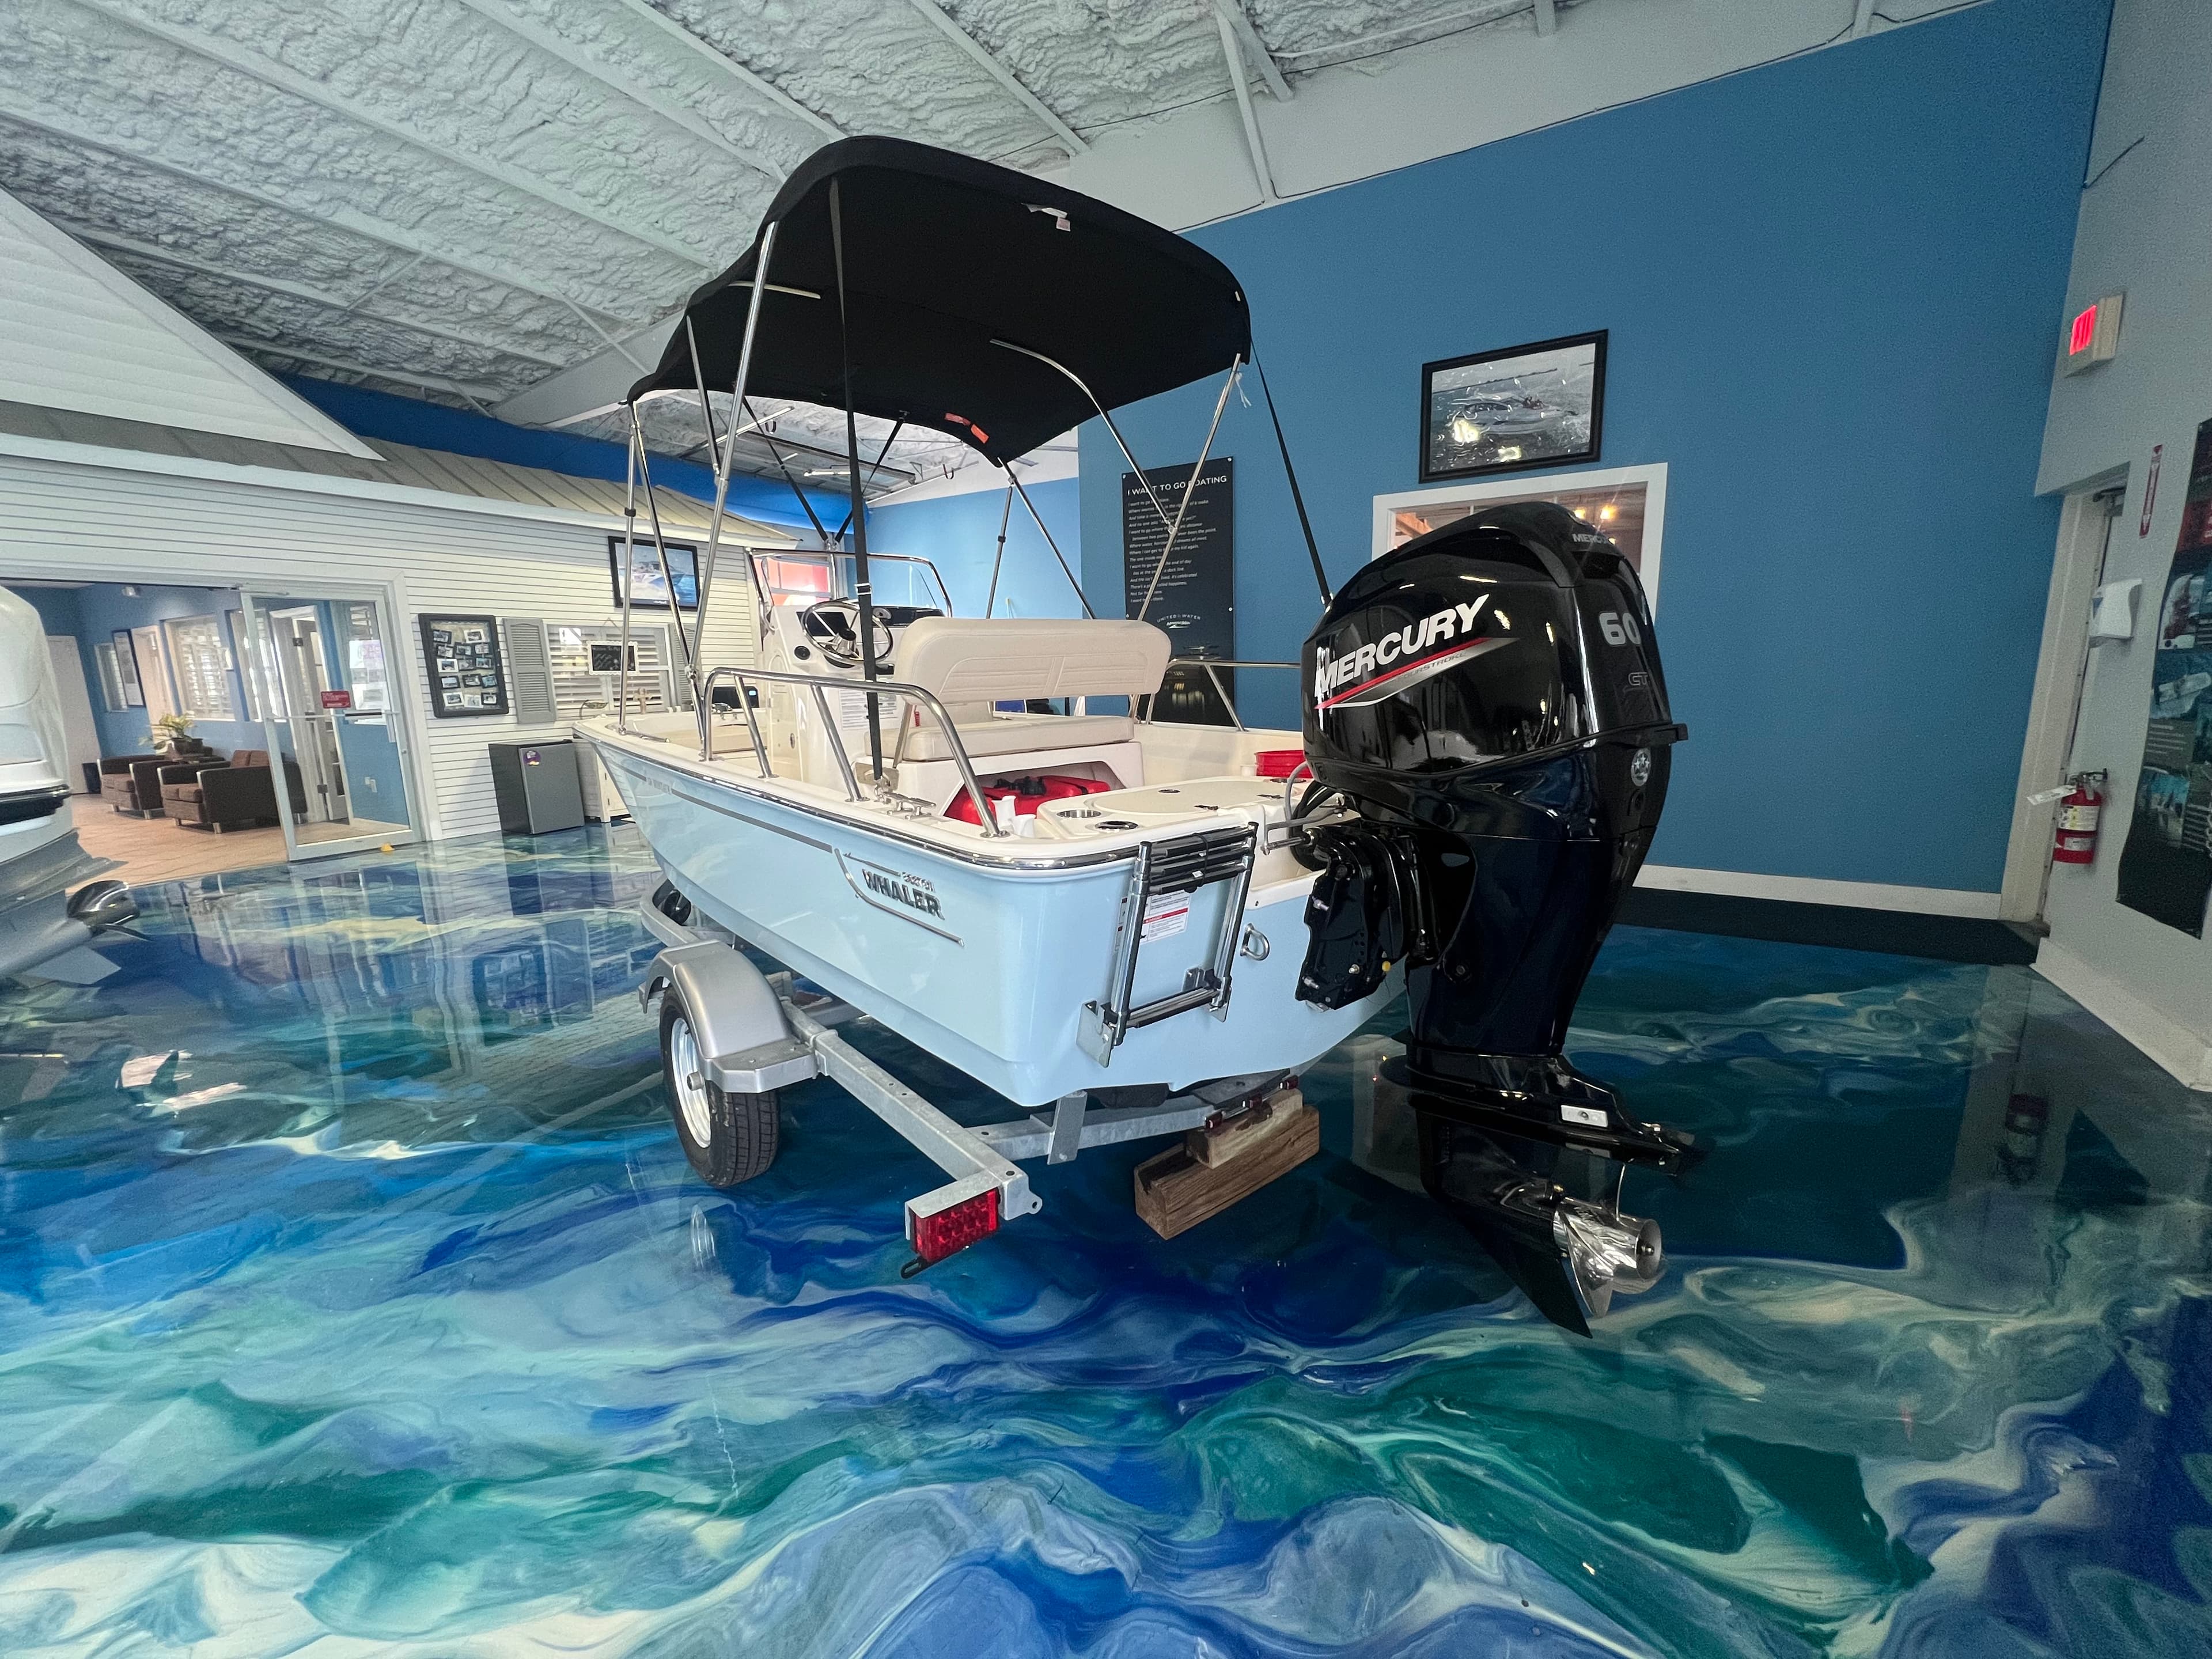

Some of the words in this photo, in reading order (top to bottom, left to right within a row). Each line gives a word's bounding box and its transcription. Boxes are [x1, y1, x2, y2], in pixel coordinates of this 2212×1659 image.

[1131, 485, 1157, 495] WAT
[1160, 483, 1171, 491] TO
[1173, 481, 1185, 490] GO
[1190, 475, 1227, 487] OATING
[1157, 613, 1177, 623] UNITED
[1599, 612, 1642, 646] 60
[1315, 593, 1490, 698] MERCURY
[1628, 672, 1648, 686] GT
[862, 868, 945, 921] WHALER
